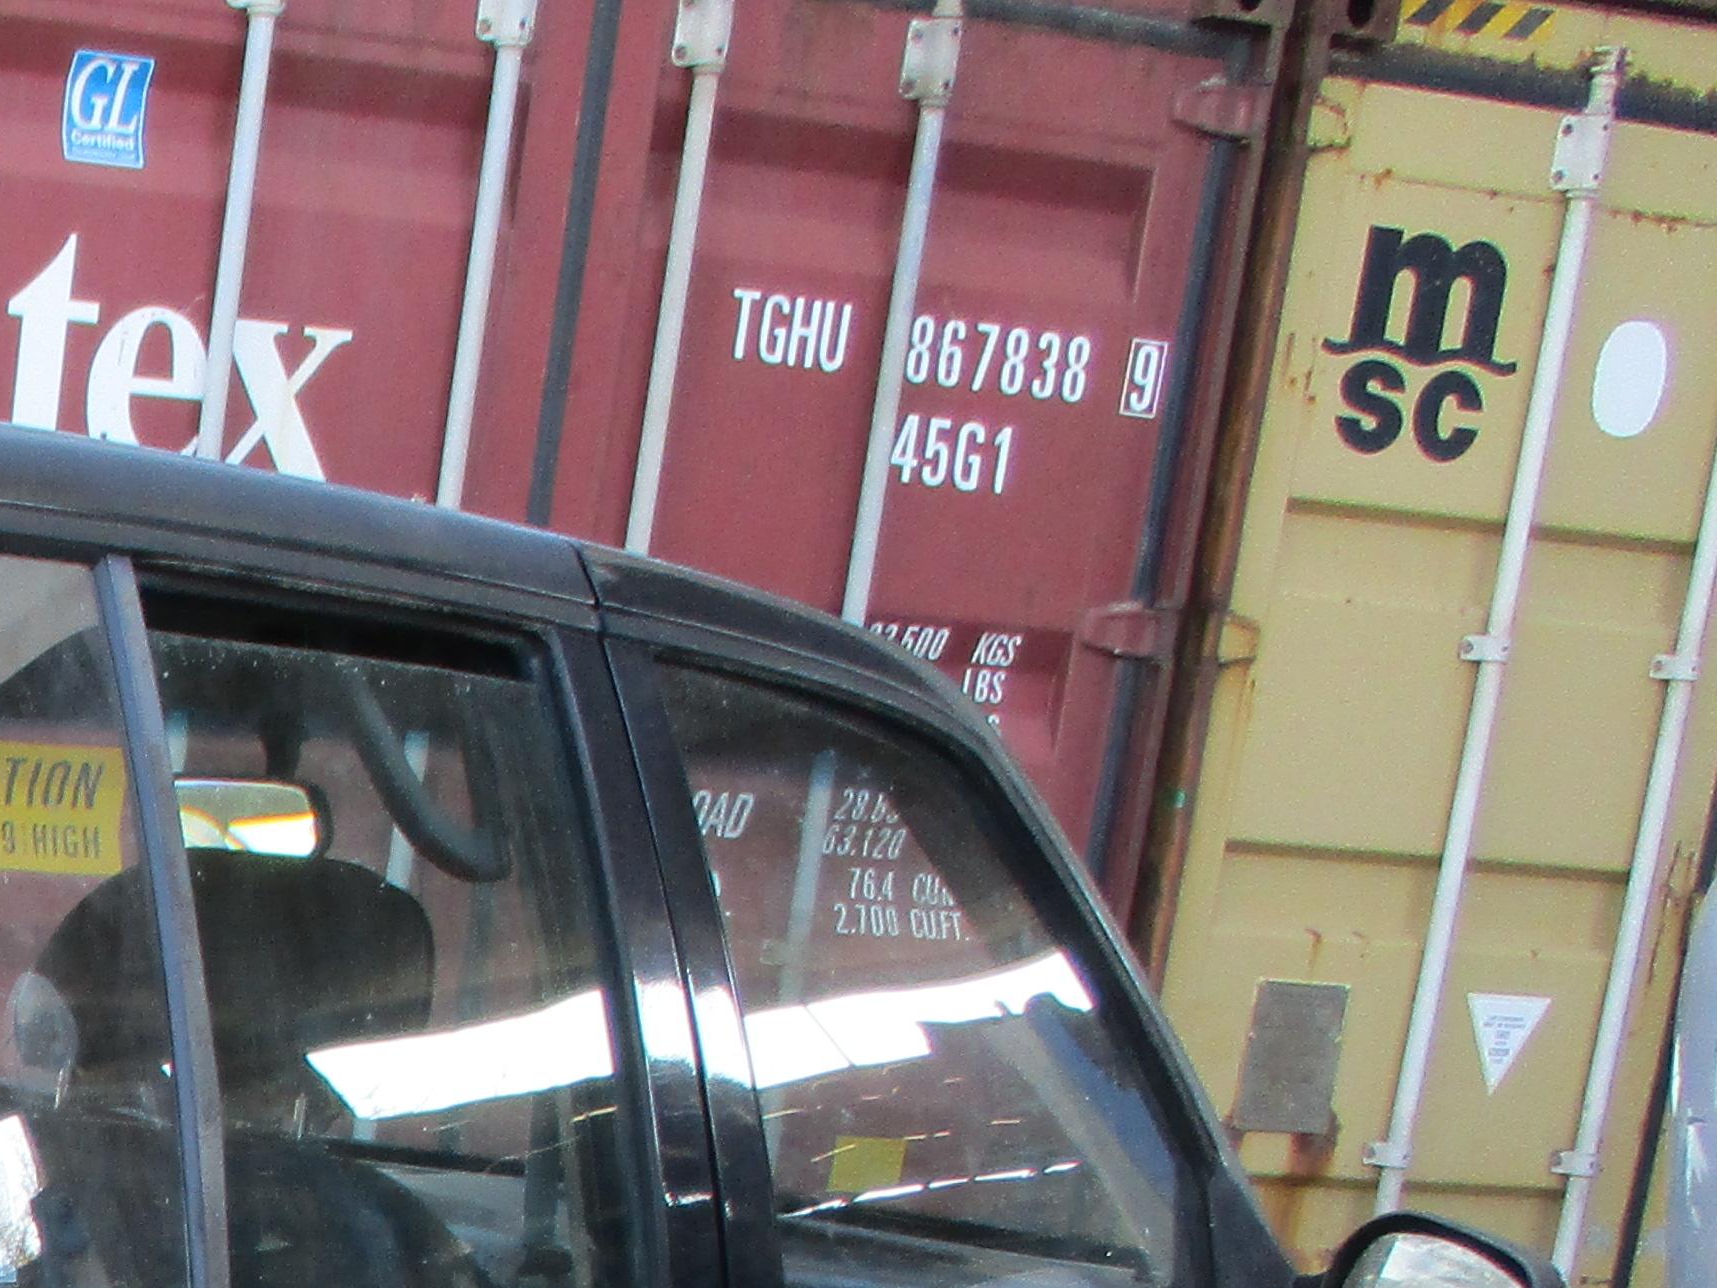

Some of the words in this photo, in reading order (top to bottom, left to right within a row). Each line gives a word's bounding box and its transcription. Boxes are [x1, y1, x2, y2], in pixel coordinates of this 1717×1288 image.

[71, 56, 140, 134] GL
[71, 129, 135, 151] Certified
[7, 233, 353, 481] tex
[733, 288, 853, 372] TGHU
[905, 315, 1091, 403] 867838
[1125, 342, 1164, 415] 9
[891, 414, 1014, 495] 45G1
[971, 632, 1024, 667] KGS
[32, 822, 101, 860] HIGH
[849, 867, 895, 902] 76.4
[833, 903, 900, 937] 2.700
